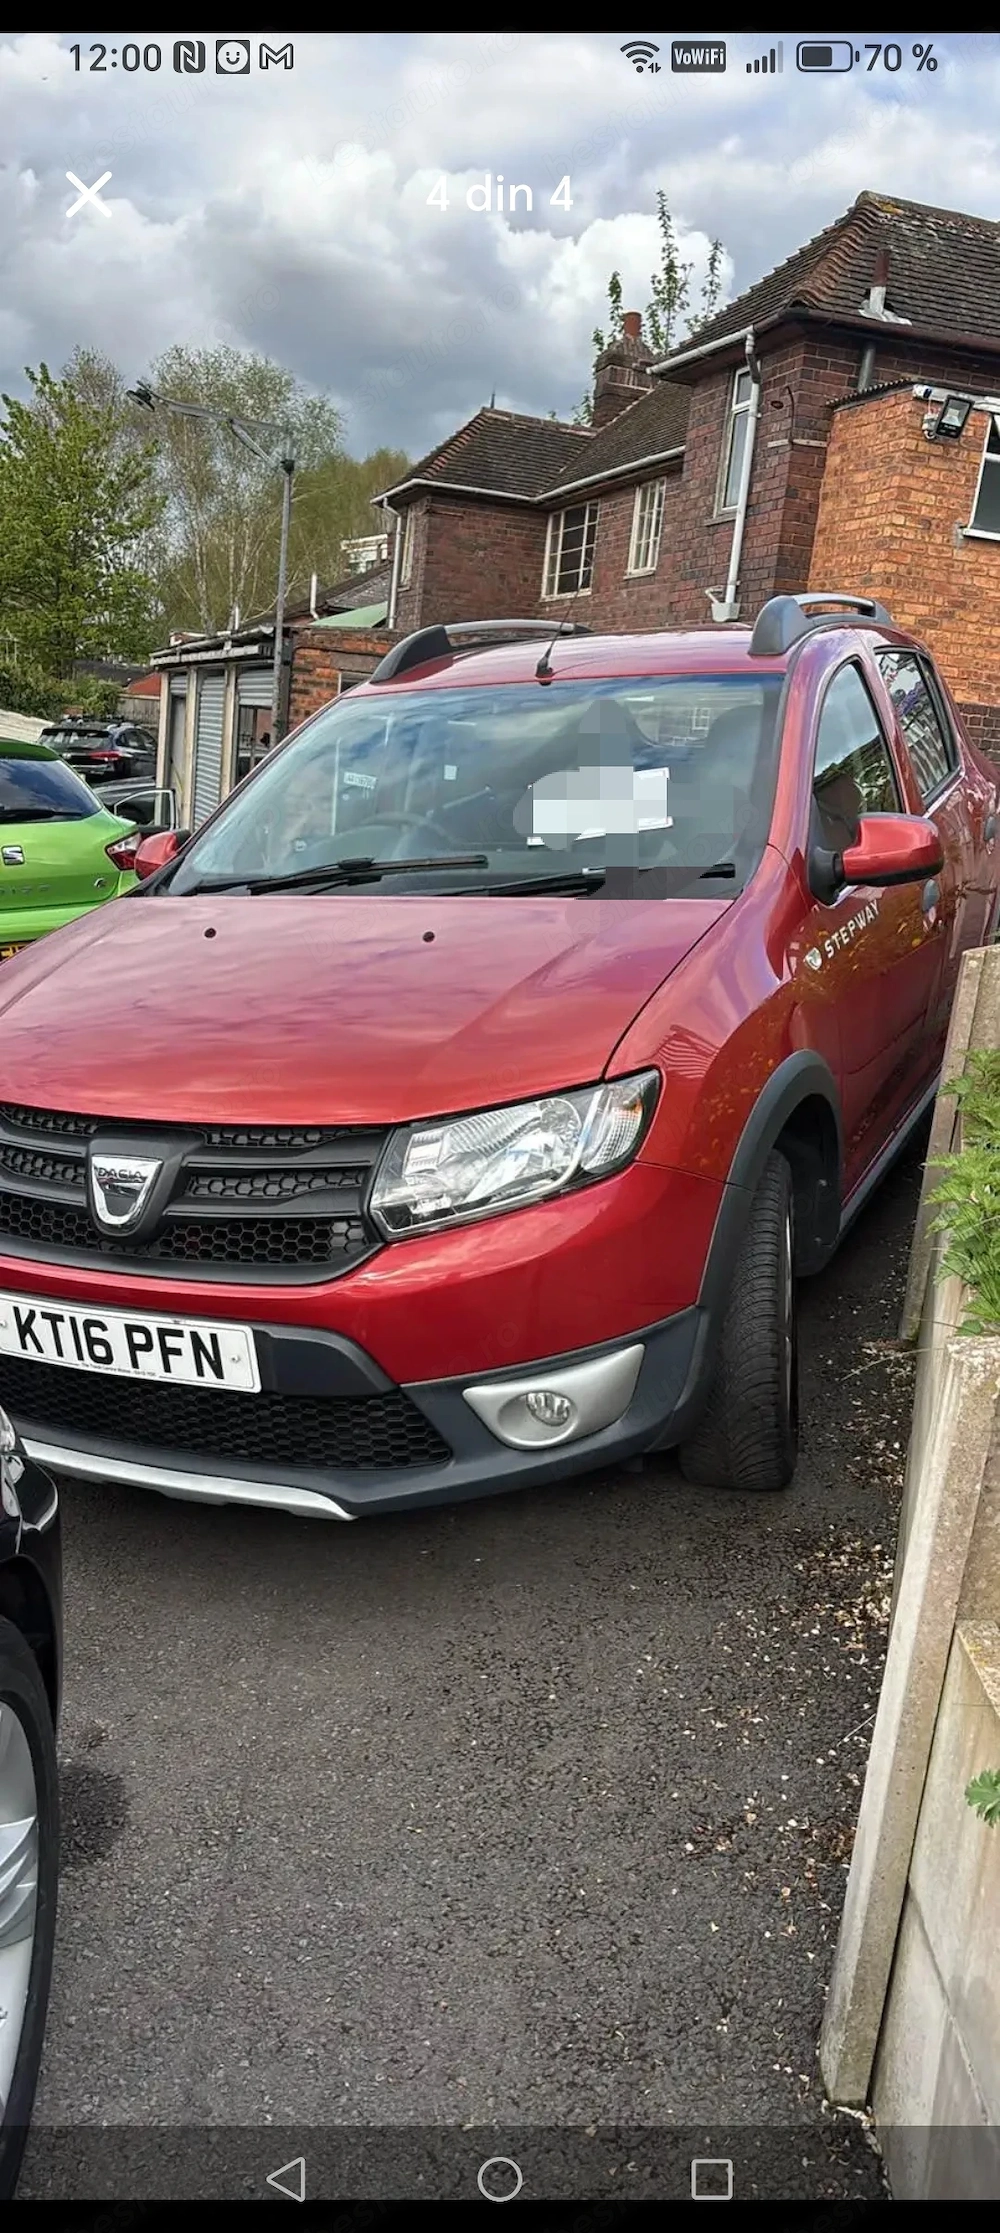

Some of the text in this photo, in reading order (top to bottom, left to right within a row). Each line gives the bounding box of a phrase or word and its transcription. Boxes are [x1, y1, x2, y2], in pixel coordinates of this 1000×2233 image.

[824, 899, 879, 959] STEPWAY
[13, 1306, 225, 1380] KT16 PFN
